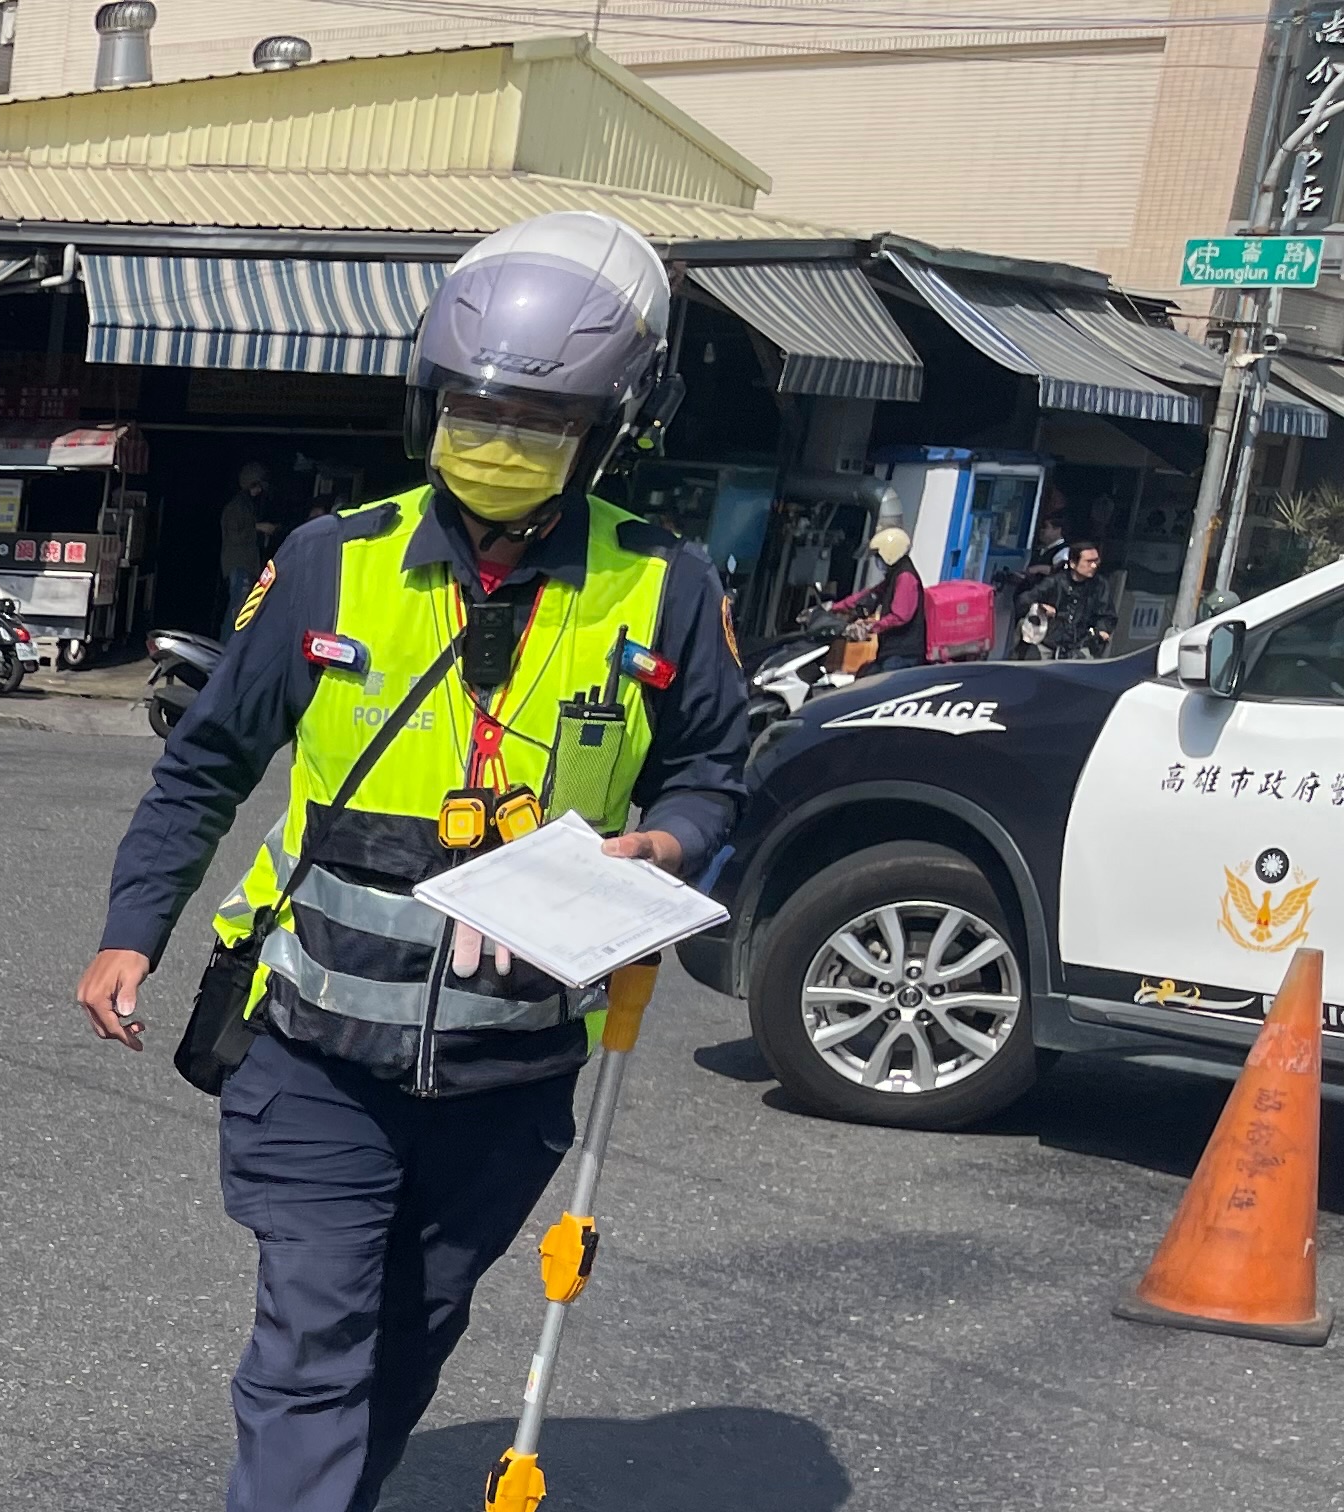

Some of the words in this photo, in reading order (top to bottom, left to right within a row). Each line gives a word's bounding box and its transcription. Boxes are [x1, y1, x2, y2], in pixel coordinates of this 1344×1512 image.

[1197, 241, 1305, 263] 中崙路
[1193, 264, 1269, 284] Zhonglun
[353, 706, 436, 730] POCE
[871, 700, 999, 722] POLICE
